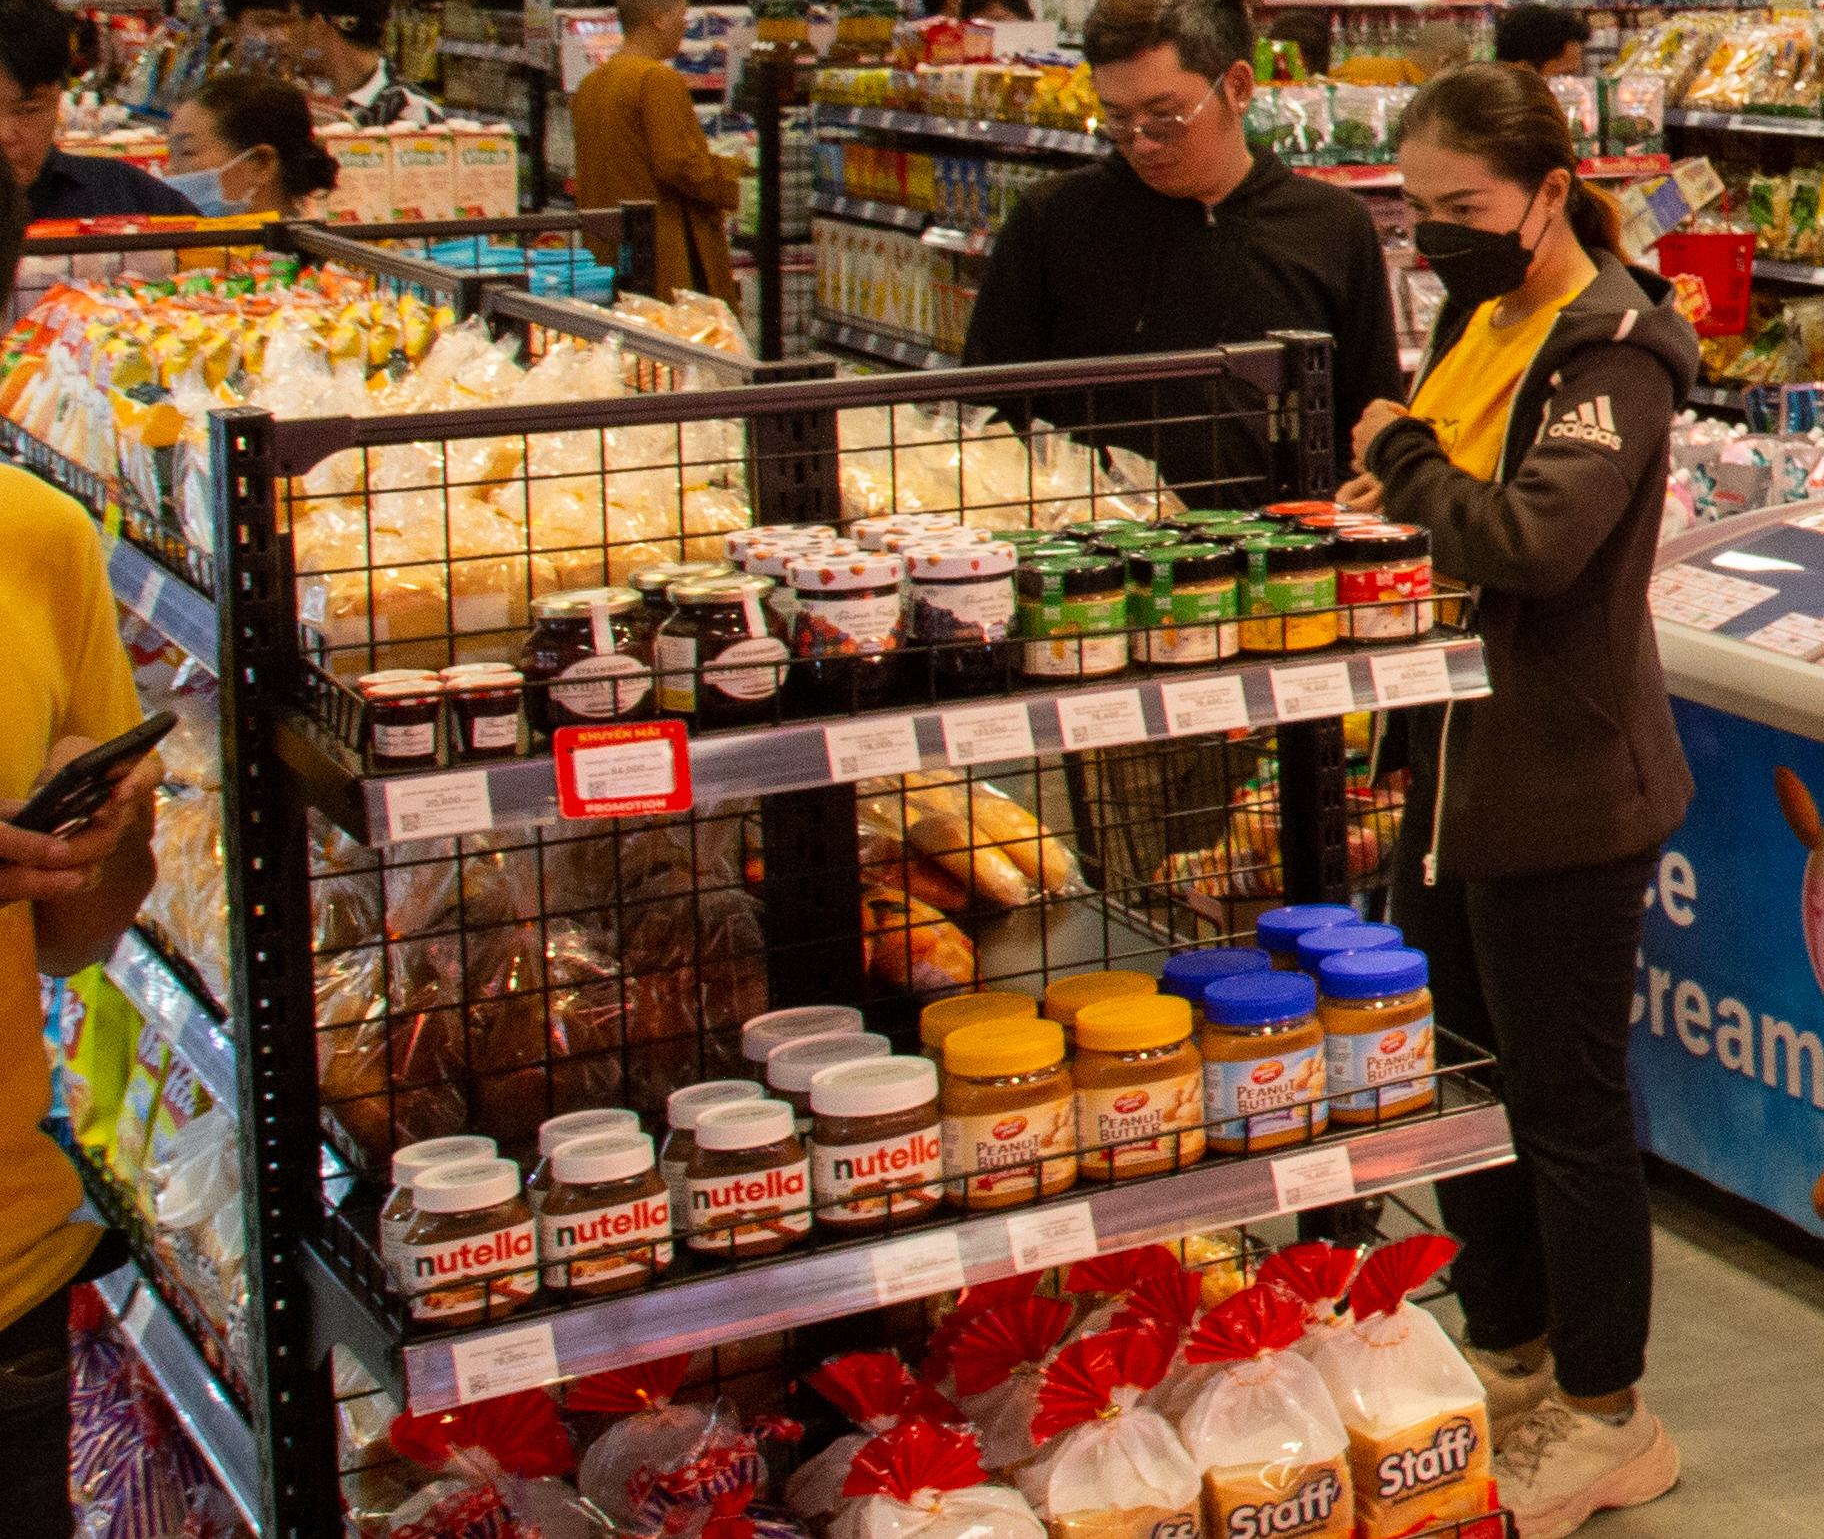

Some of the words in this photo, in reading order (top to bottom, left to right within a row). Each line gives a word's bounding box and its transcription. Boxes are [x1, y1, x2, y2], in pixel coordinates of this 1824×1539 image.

[1548, 418, 1622, 451] adidas
[585, 798, 666, 812] PROMOTION
[1366, 1048, 1415, 1070] PEANUT
[1367, 1062, 1415, 1083] BUTTER
[1236, 1079, 1294, 1100] PEANUT
[1238, 1092, 1295, 1112] BUTTER
[1100, 1109, 1162, 1129] PEANUT
[1100, 1122, 1161, 1142] BUTTER
[833, 1129, 940, 1182] nutella
[976, 1133, 1041, 1157] PEANUT
[977, 1148, 1039, 1171] BUTTER
[691, 1166, 806, 1211] nutella
[555, 1198, 670, 1249] nutella
[415, 1223, 534, 1278] nutella
[1377, 1418, 1478, 1498] Staff
[1229, 1470, 1341, 1539] Staff
